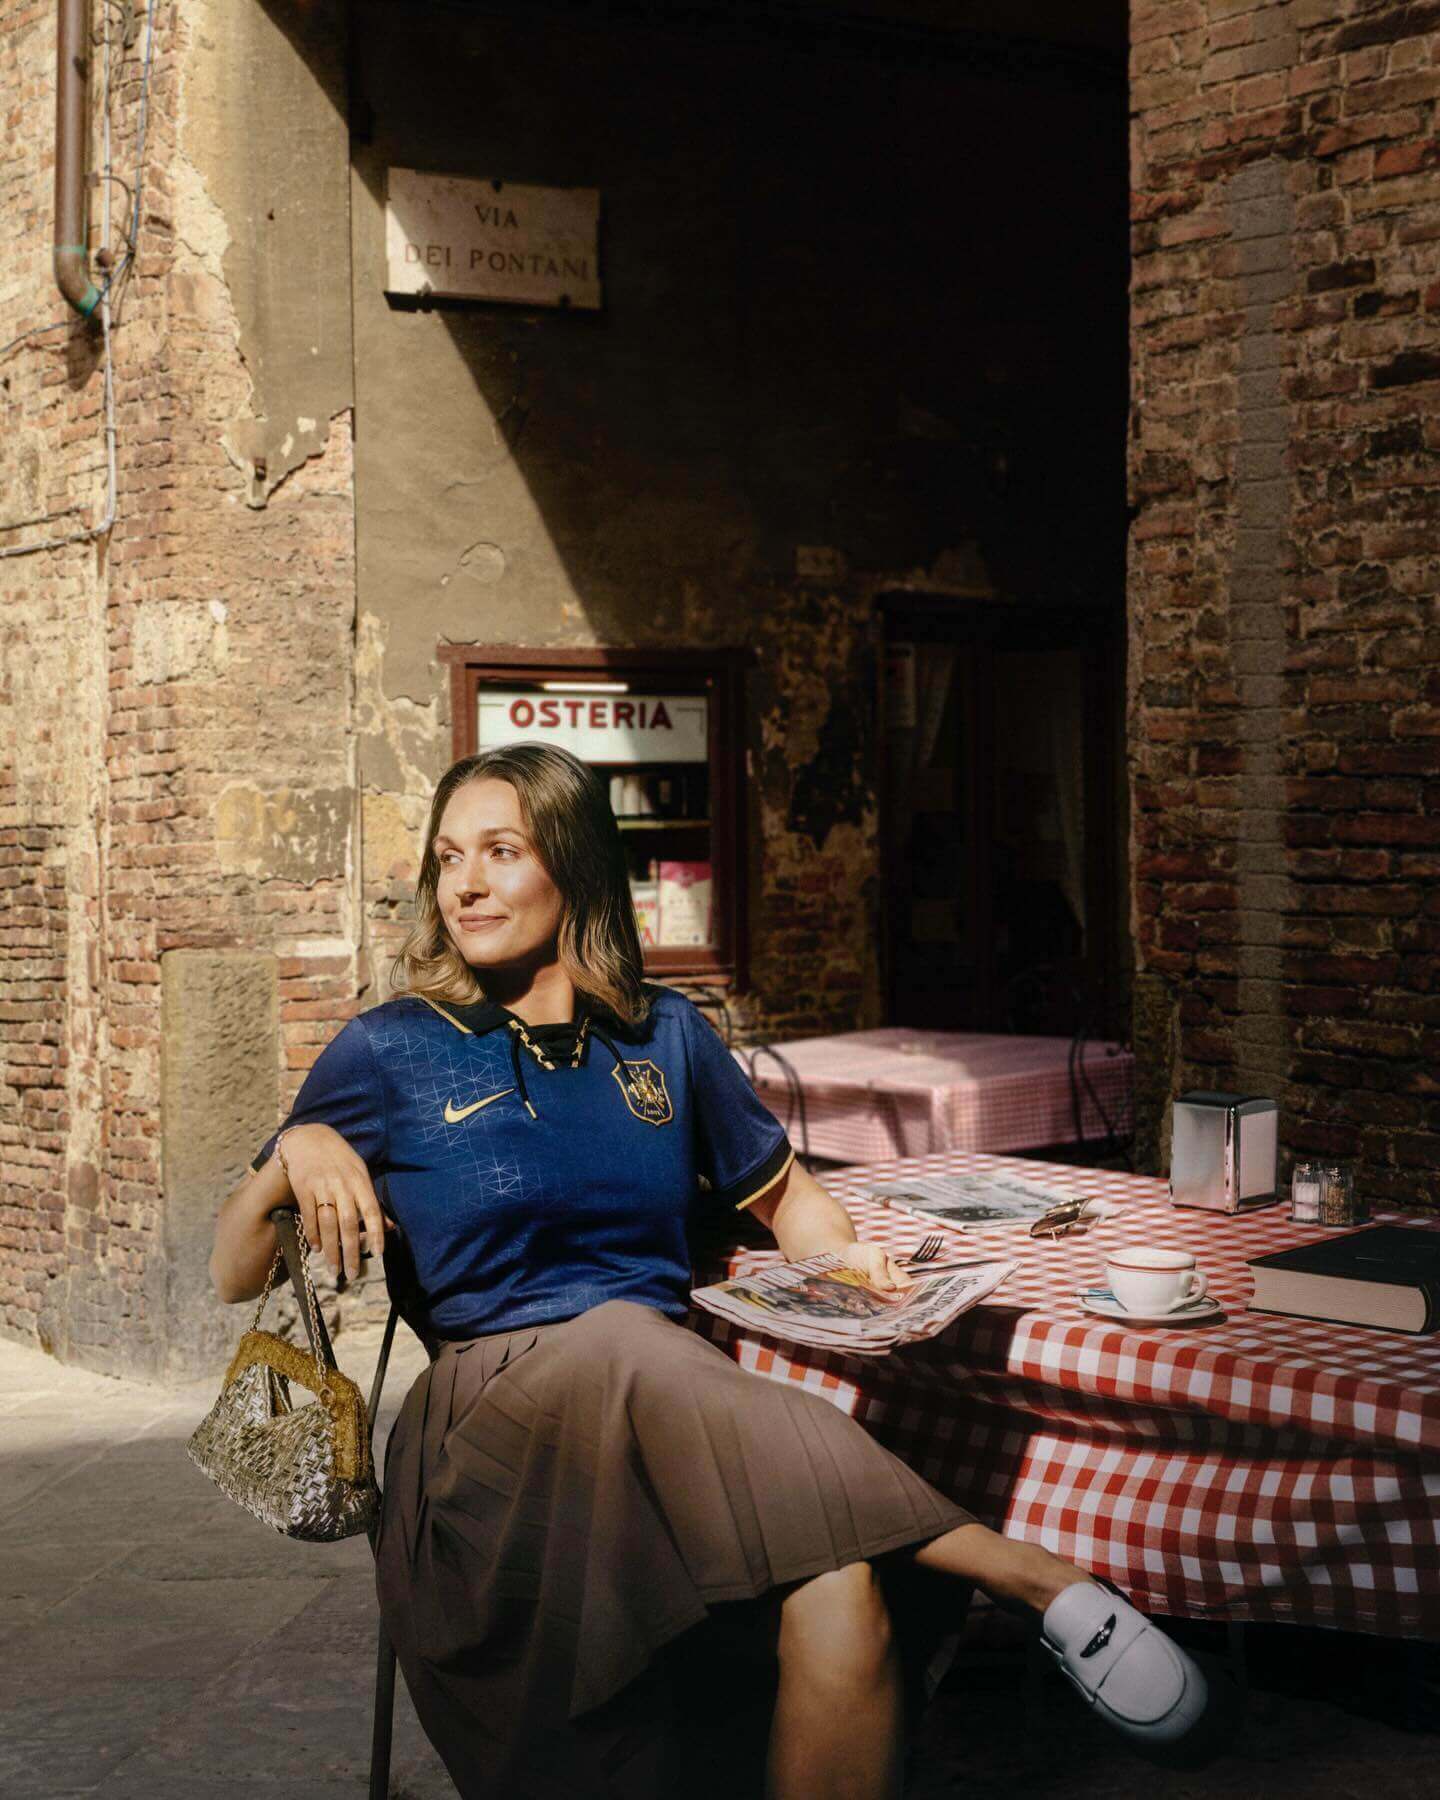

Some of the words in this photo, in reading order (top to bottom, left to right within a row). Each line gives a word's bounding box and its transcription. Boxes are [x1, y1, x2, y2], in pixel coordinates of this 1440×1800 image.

[475, 206, 519, 229] VIA
[404, 243, 452, 268] DEI
[470, 249, 588, 281] PONTANI
[509, 698, 672, 729] OSTERIA
